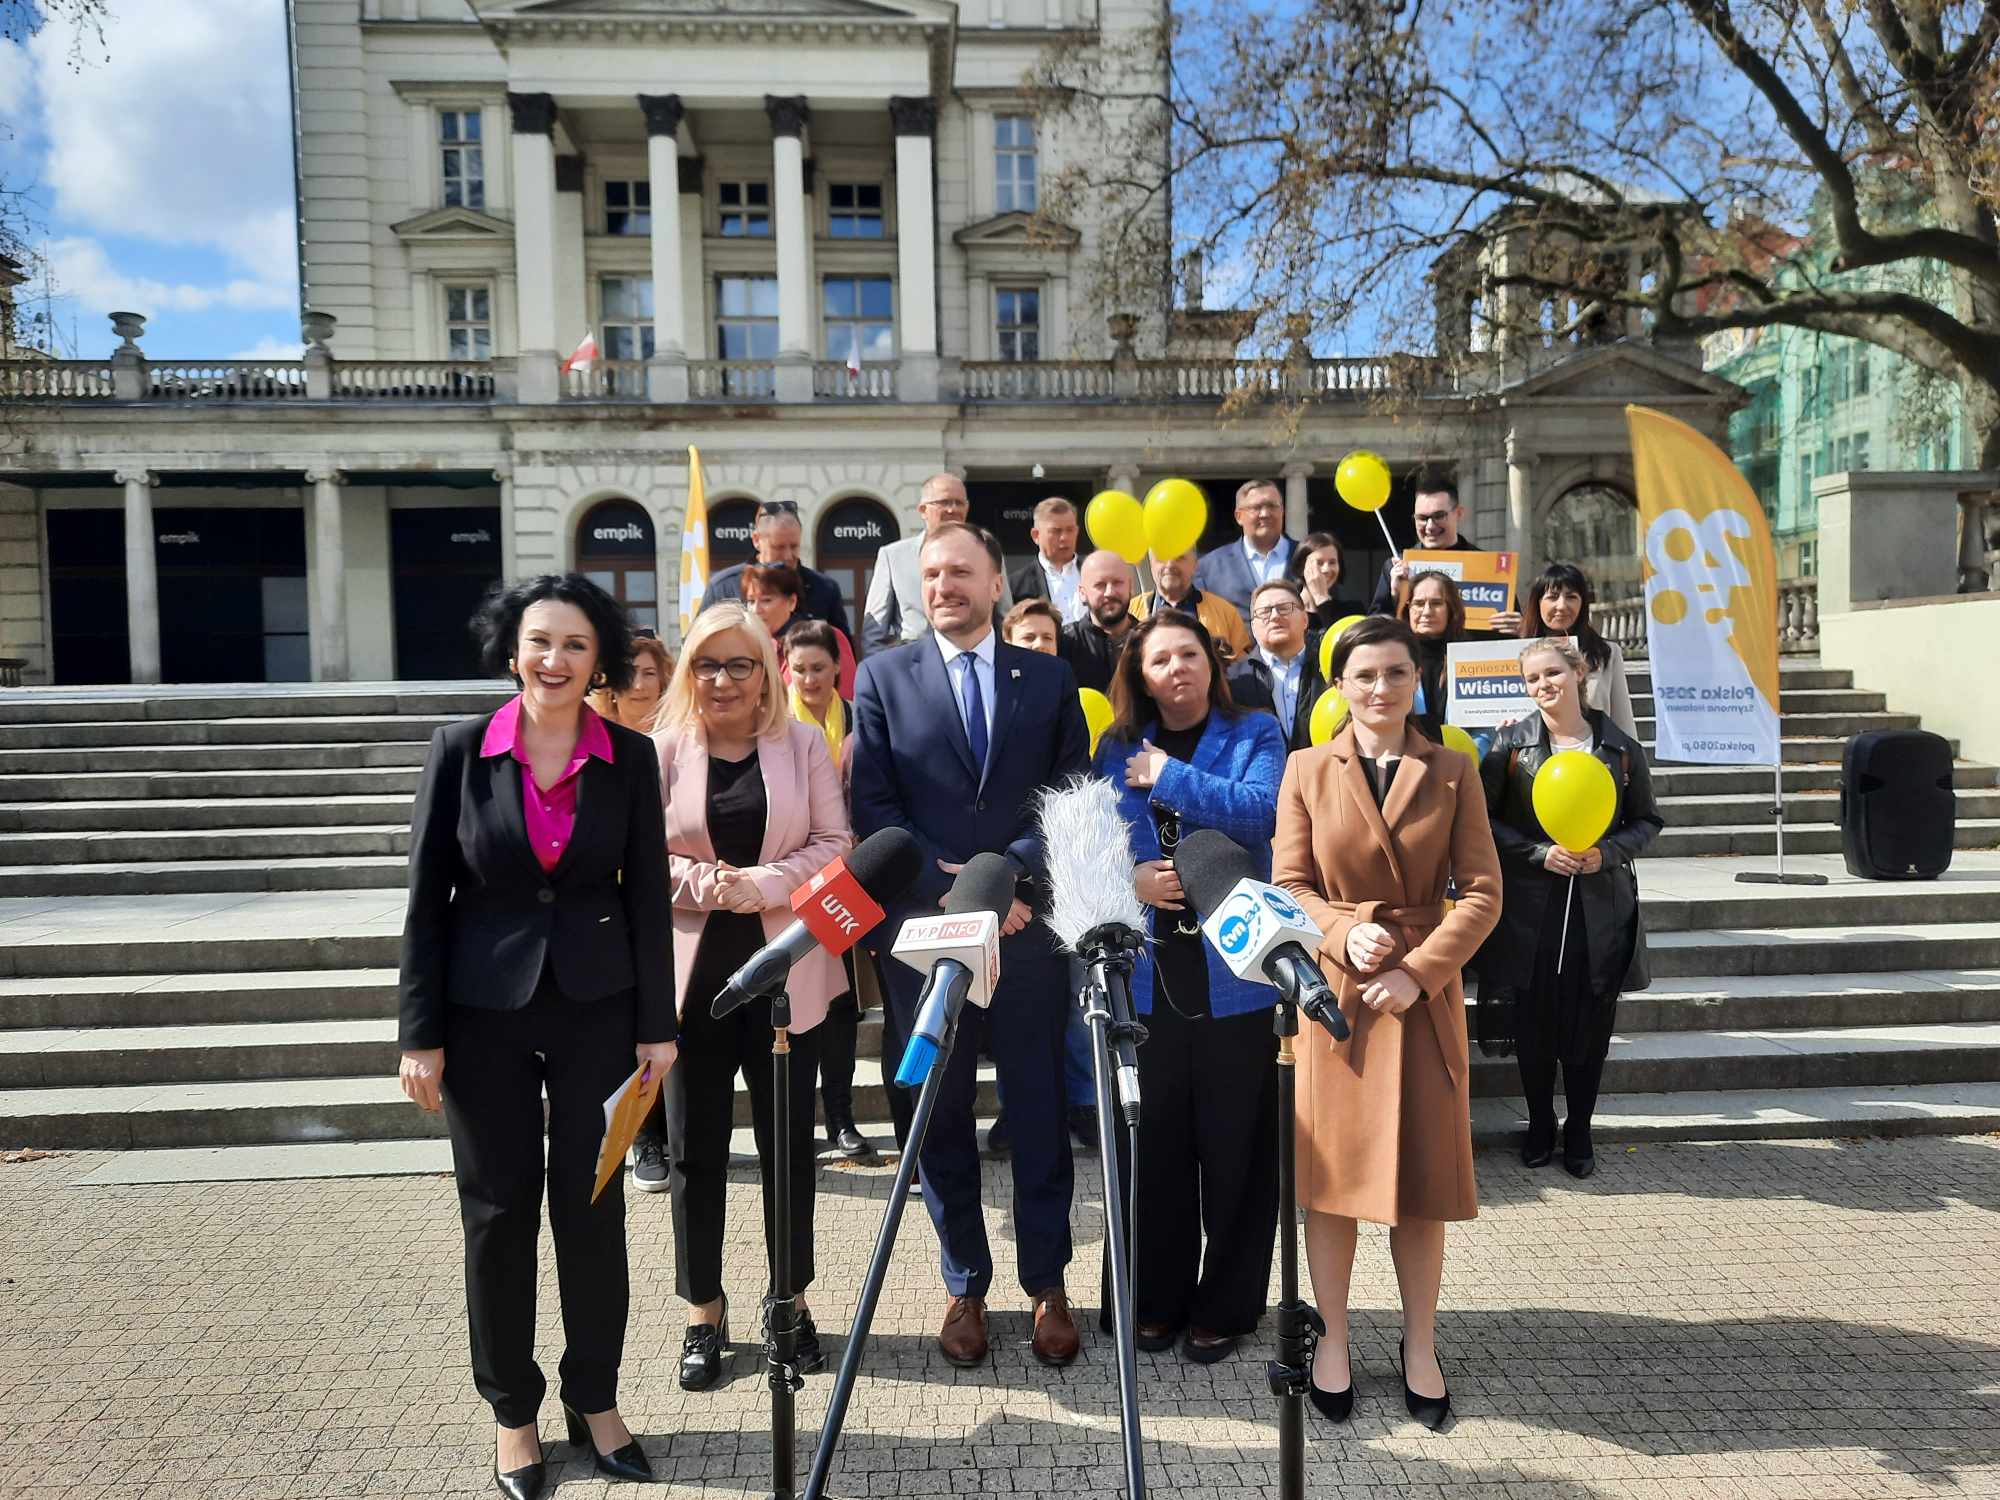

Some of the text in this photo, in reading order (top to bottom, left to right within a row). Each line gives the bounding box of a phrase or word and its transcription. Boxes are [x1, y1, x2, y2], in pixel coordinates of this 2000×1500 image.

[593, 522, 643, 542] empik
[834, 521, 882, 540] empik
[1500, 555, 1507, 568] 1
[1459, 586, 1504, 602] stka
[940, 921, 981, 938] INFO
